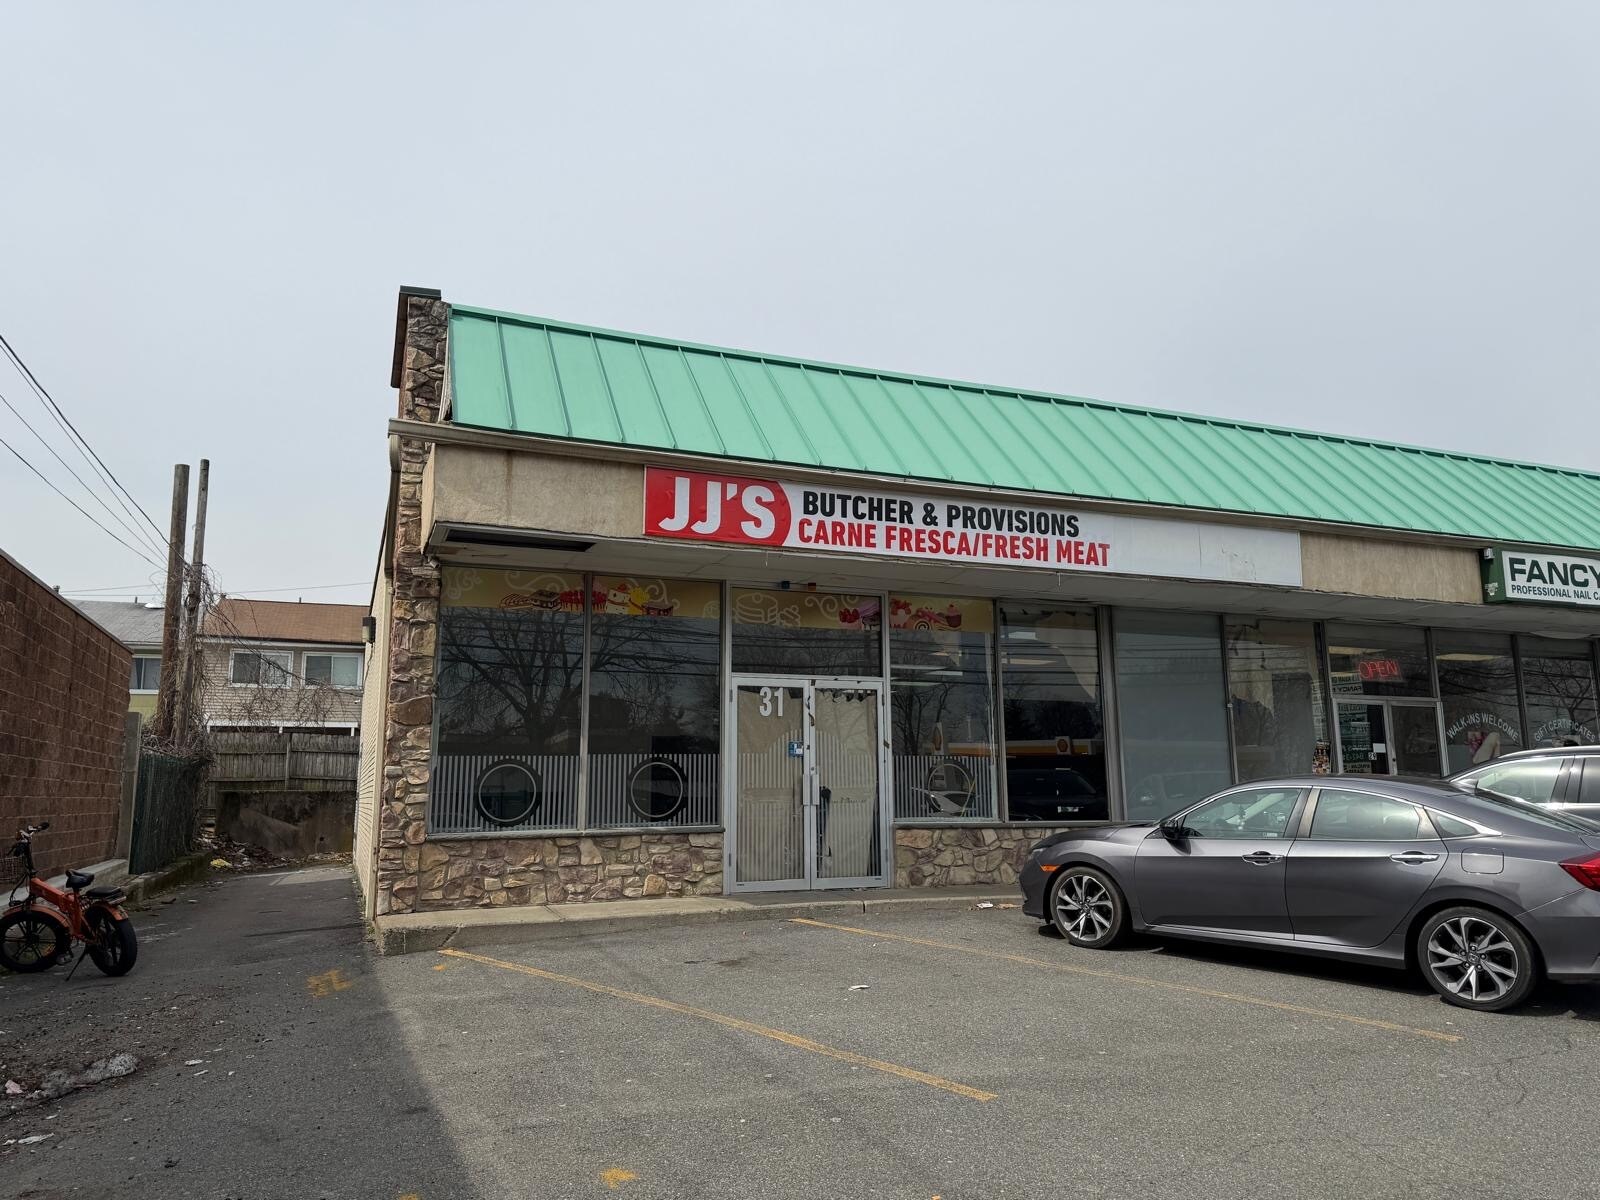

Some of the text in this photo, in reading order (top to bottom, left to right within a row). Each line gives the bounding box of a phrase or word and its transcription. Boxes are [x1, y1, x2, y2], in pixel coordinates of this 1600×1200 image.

[658, 476, 777, 540] JJ'S
[803, 489, 1080, 538] BUTCHER & PROVISIONS
[798, 517, 1112, 567] CARNE FRESCA/FRESH MEAT
[1508, 557, 1600, 589] FANCY
[1511, 584, 1572, 598] PROFESSIONAL
[1573, 589, 1592, 600] NAIL
[1358, 659, 1399, 680] OPEN
[758, 686, 784, 717] 31
[1446, 711, 1520, 742] WALK-INS WELCOME
[1534, 718, 1596, 743] GIFT CERTIFICATES
